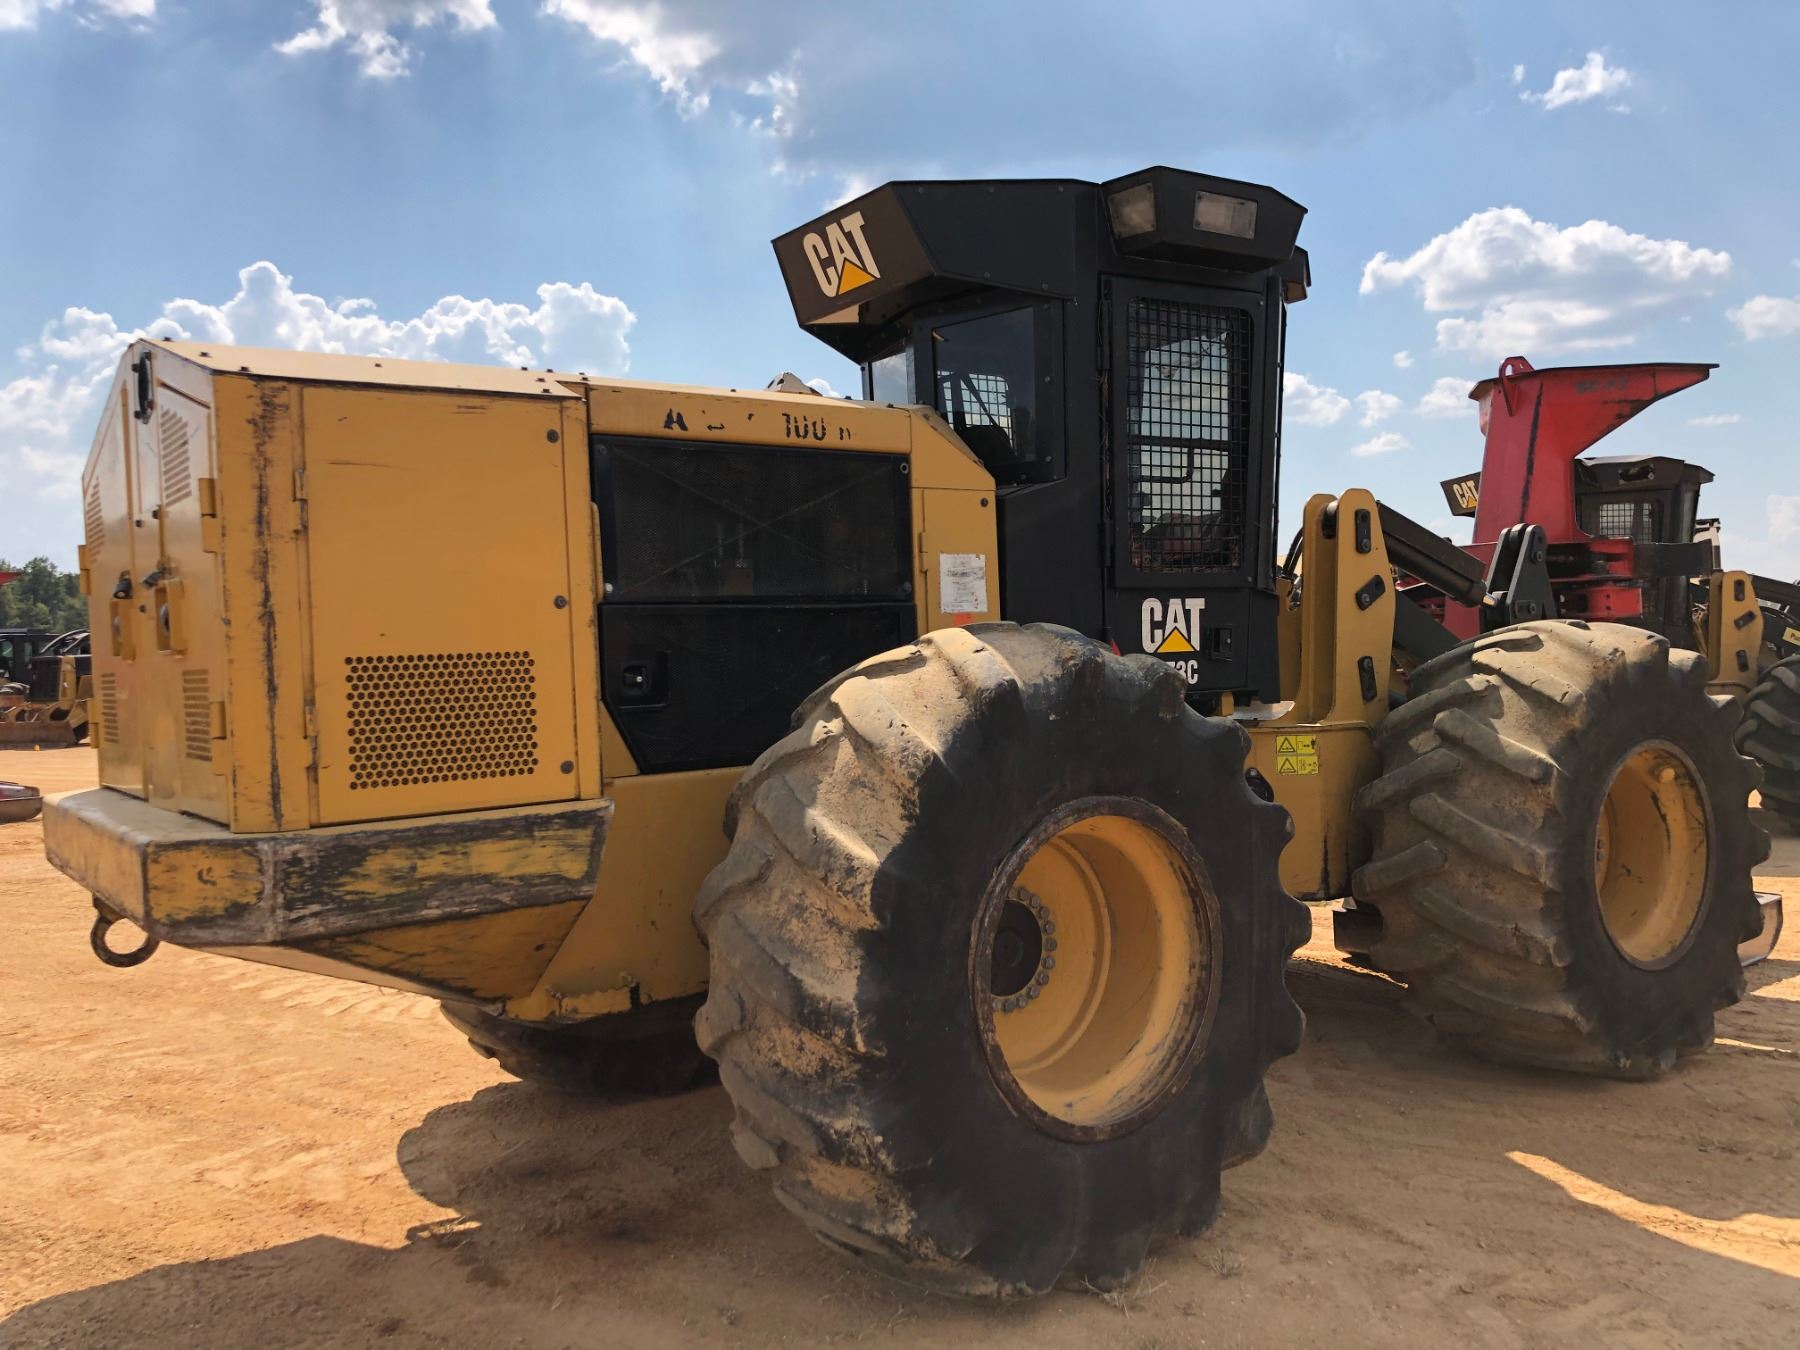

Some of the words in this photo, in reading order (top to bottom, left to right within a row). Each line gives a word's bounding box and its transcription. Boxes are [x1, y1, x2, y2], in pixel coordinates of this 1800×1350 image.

[803, 211, 881, 298] CAT
[1452, 480, 1479, 509] CAT
[1141, 597, 1206, 654] CAT
